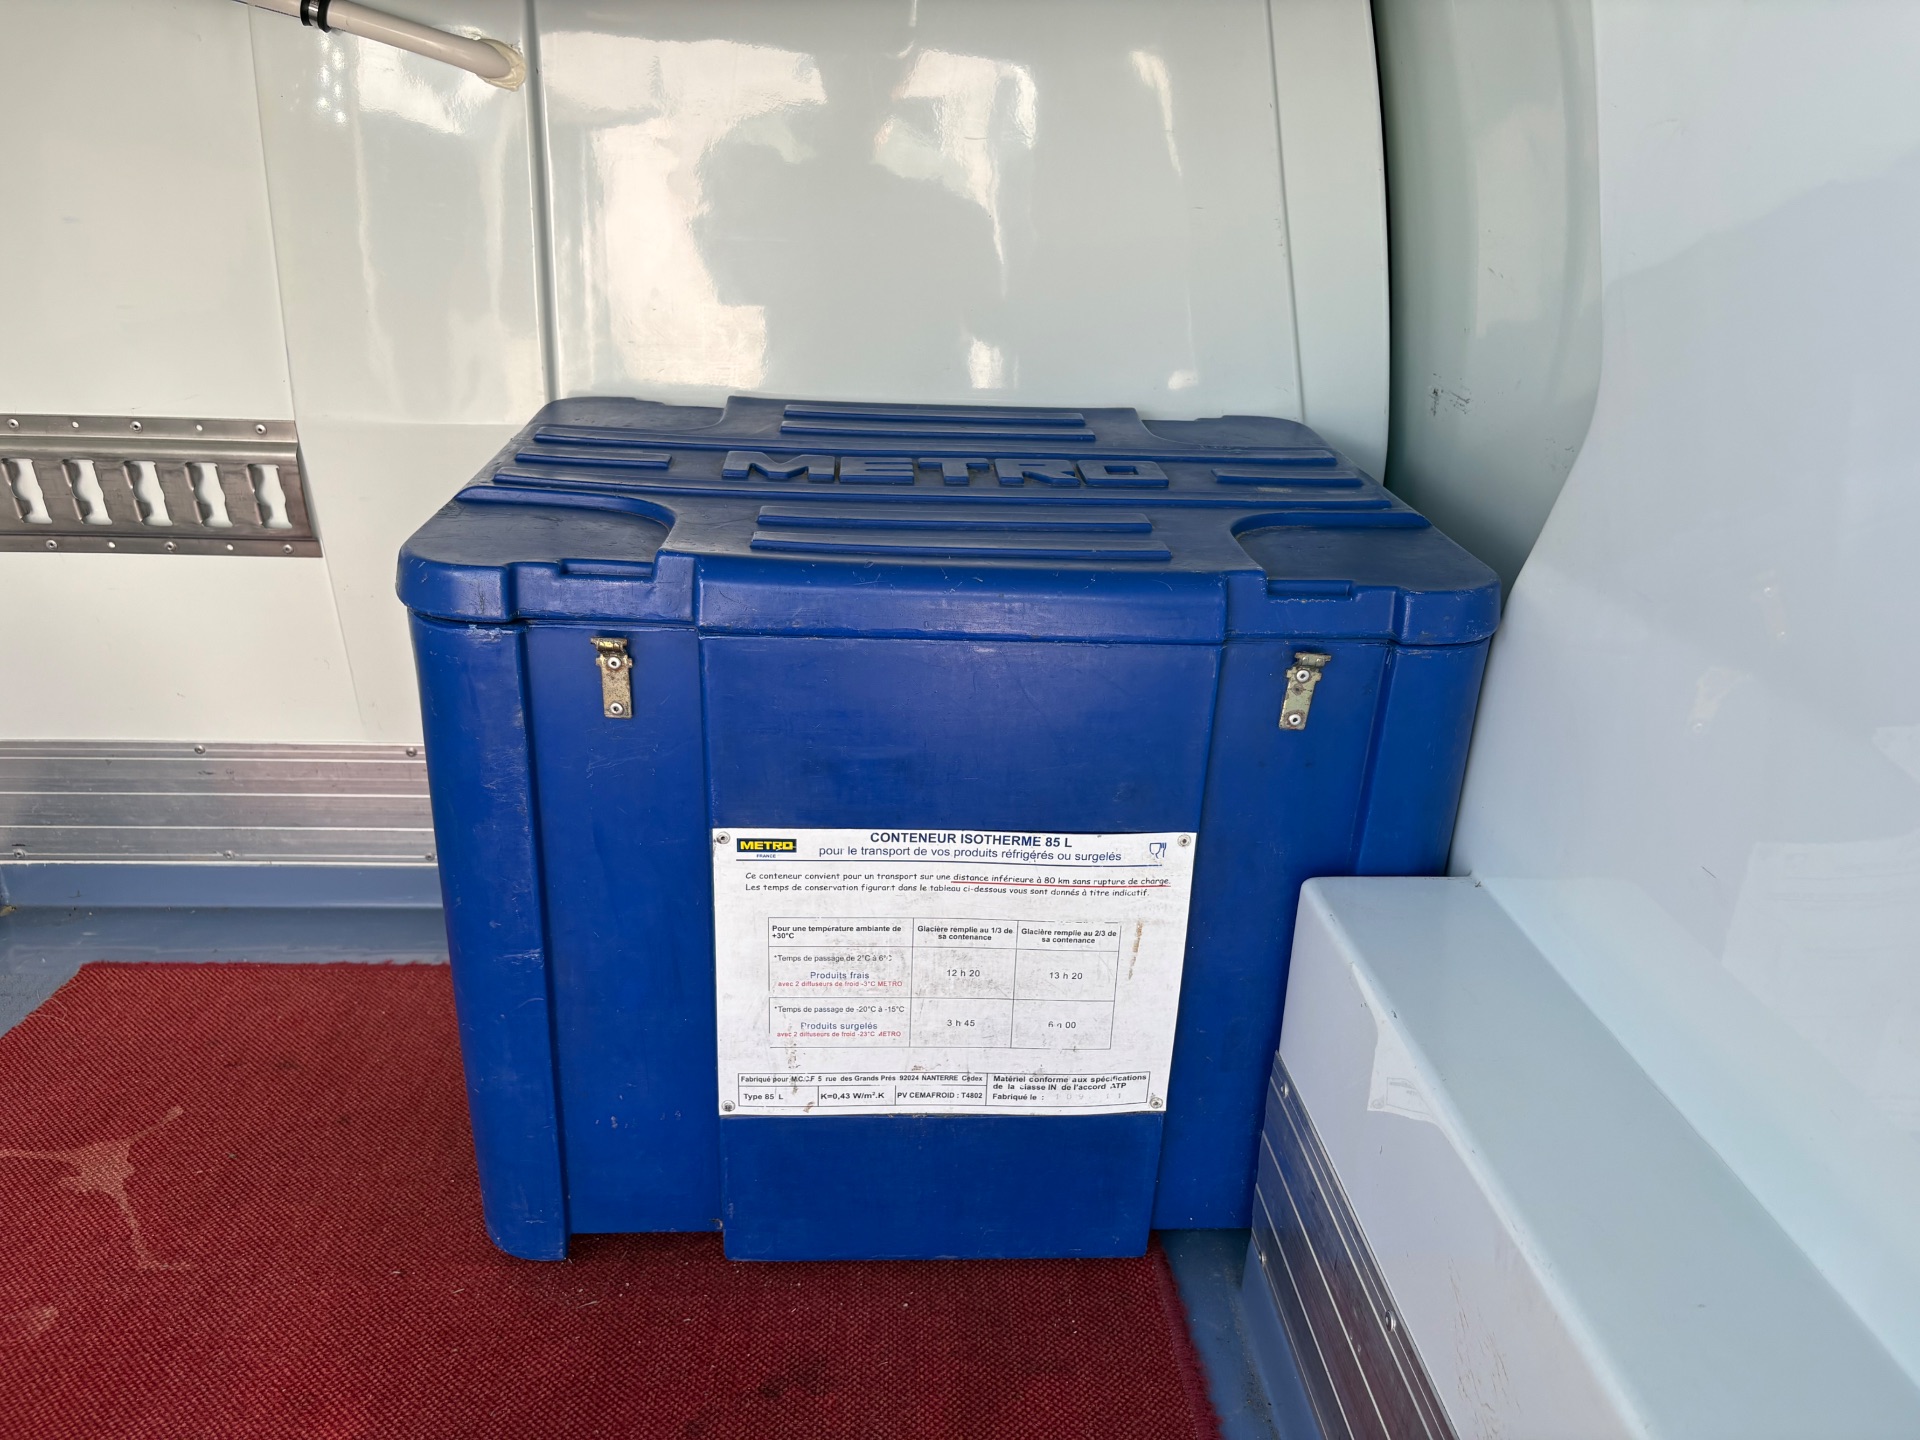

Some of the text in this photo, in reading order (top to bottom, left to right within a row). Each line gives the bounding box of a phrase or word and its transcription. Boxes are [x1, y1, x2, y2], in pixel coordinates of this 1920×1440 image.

[720, 449, 1170, 489] METRO
[870, 832, 1073, 848] CONTENEUR ISOTHERME 85 L
[740, 840, 794, 851] METRO
[818, 845, 1122, 863] pour le transport de vos produits réfrigérés ou surgelés
[745, 872, 757, 880] Ce
[804, 872, 840, 880] convient
[842, 873, 862, 882] pour
[876, 873, 918, 882] transport
[953, 873, 989, 882] distance
[991, 873, 1034, 884] inférieure
[1036, 876, 1042, 884] à
[1044, 876, 1056, 885] 80
[1057, 876, 1070, 885] km
[1072, 878, 1091, 886] sans
[1093, 878, 1126, 887] rupture
[1127, 877, 1138, 885] de
[1140, 877, 1172, 886] charge.
[745, 883, 1150, 897] Les temps de conservation figurant dans le tableau ci-dessous vous sont donnés à titre indicatif.
[771, 924, 791, 933] Pour
[808, 924, 854, 933] température
[917, 925, 949, 934] Glacière
[949, 926, 978, 936] remplie
[991, 926, 1003, 935] 1/3
[1003, 927, 1013, 935] de
[1021, 927, 1053, 937] Glacière
[1053, 928, 1083, 938] remplie
[1094, 929, 1106, 937] 2/3
[1107, 929, 1117, 937] de
[771, 932, 795, 940] +30°C
[1041, 936, 1096, 944] sa contenance
[803, 954, 813, 962] de
[813, 955, 845, 963] passage
[845, 954, 856, 962] de
[856, 954, 871, 962] 2°C
[872, 954, 877, 962] à
[809, 971, 870, 980] Produits frais
[946, 969, 981, 978] 12 h 20
[1049, 971, 1084, 980] 13 h 20
[802, 1005, 813, 1013] de
[813, 1006, 844, 1014] passage
[845, 1005, 855, 1013] de
[855, 1005, 877, 1013] -20°C
[877, 1005, 883, 1013] à
[884, 1005, 905, 1013] -15°C
[800, 1021, 878, 1031] Produits surgelés
[946, 1019, 976, 1028] 3 h 45
[1047, 1020, 1055, 1028] 6
[1064, 1021, 1077, 1029] 00
[740, 1075, 771, 1084] Fabriqué
[772, 1076, 789, 1084] pour
[993, 1074, 1026, 1083] Matériel
[1028, 1075, 1069, 1083] conforme
[1047, 1083, 1057, 1091] IN
[1061, 1083, 1072, 1091] de
[1073, 1082, 1106, 1091] l'accord
[743, 1093, 763, 1102] Type
[820, 1092, 851, 1100] K=0,43
[908, 1091, 955, 1099] CEMAFROID
[992, 1092, 1028, 1102] Fabriqué
[1029, 1093, 1037, 1101] le
